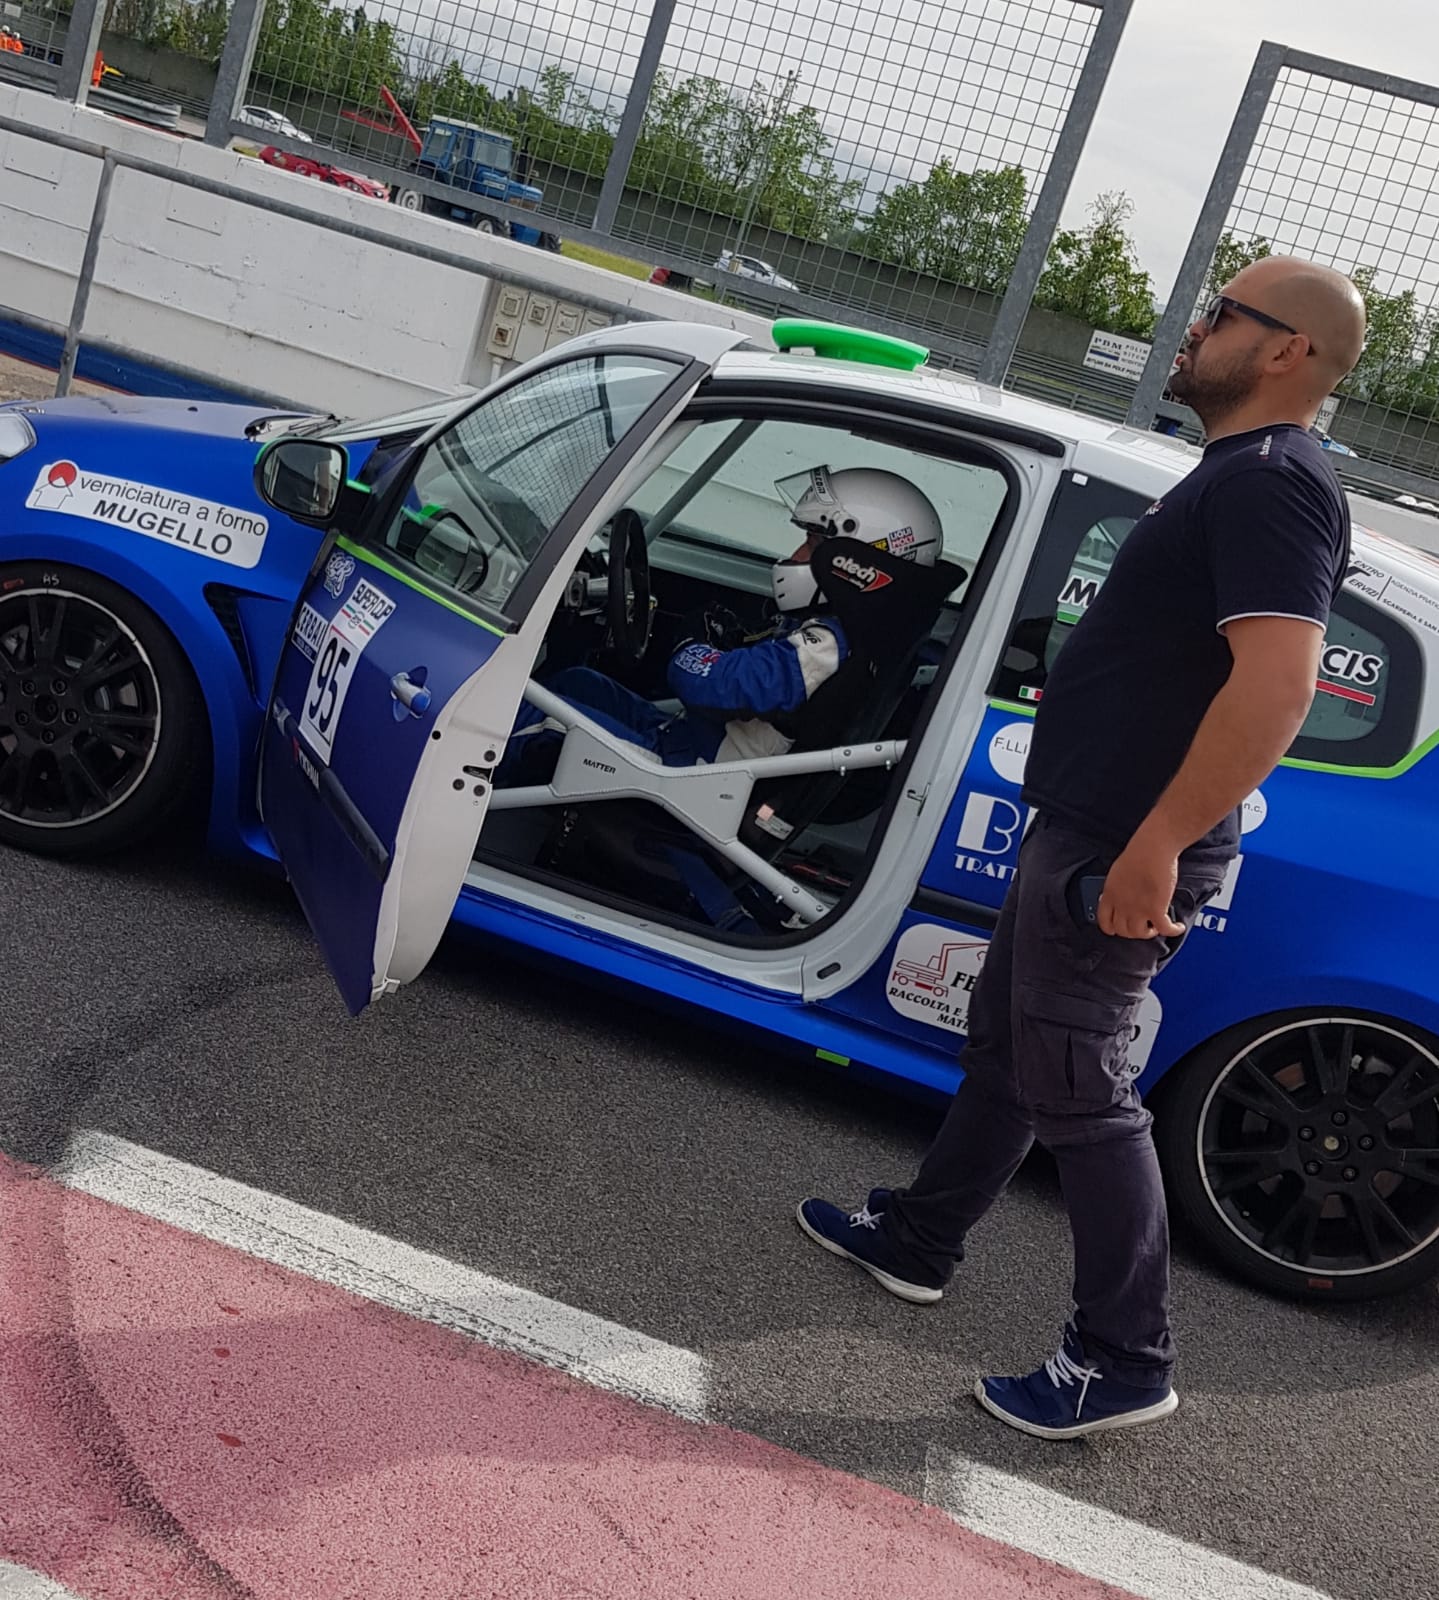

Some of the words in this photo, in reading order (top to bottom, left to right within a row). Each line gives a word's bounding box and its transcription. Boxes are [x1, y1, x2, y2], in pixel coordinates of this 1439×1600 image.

[81, 477, 190, 515] verniciatura
[196, 505, 210, 521] a
[215, 507, 266, 536] forno
[93, 500, 232, 555] MUGELLO
[1353, 560, 1385, 578] ENTRO
[1348, 578, 1379, 598] ERVIZI
[1058, 575, 1100, 608] M
[1320, 645, 1383, 685] CIS
[308, 637, 350, 733] 95
[583, 758, 616, 774] MATTER
[956, 791, 1024, 855] B
[1243, 802, 1264, 814] n.c.
[955, 853, 1017, 881] TRATT
[1194, 912, 1227, 932] ICI
[950, 970, 976, 993] FE
[888, 987, 950, 1013] RACCOLTA
[952, 1007, 962, 1017] E
[936, 1013, 968, 1031] MATE
